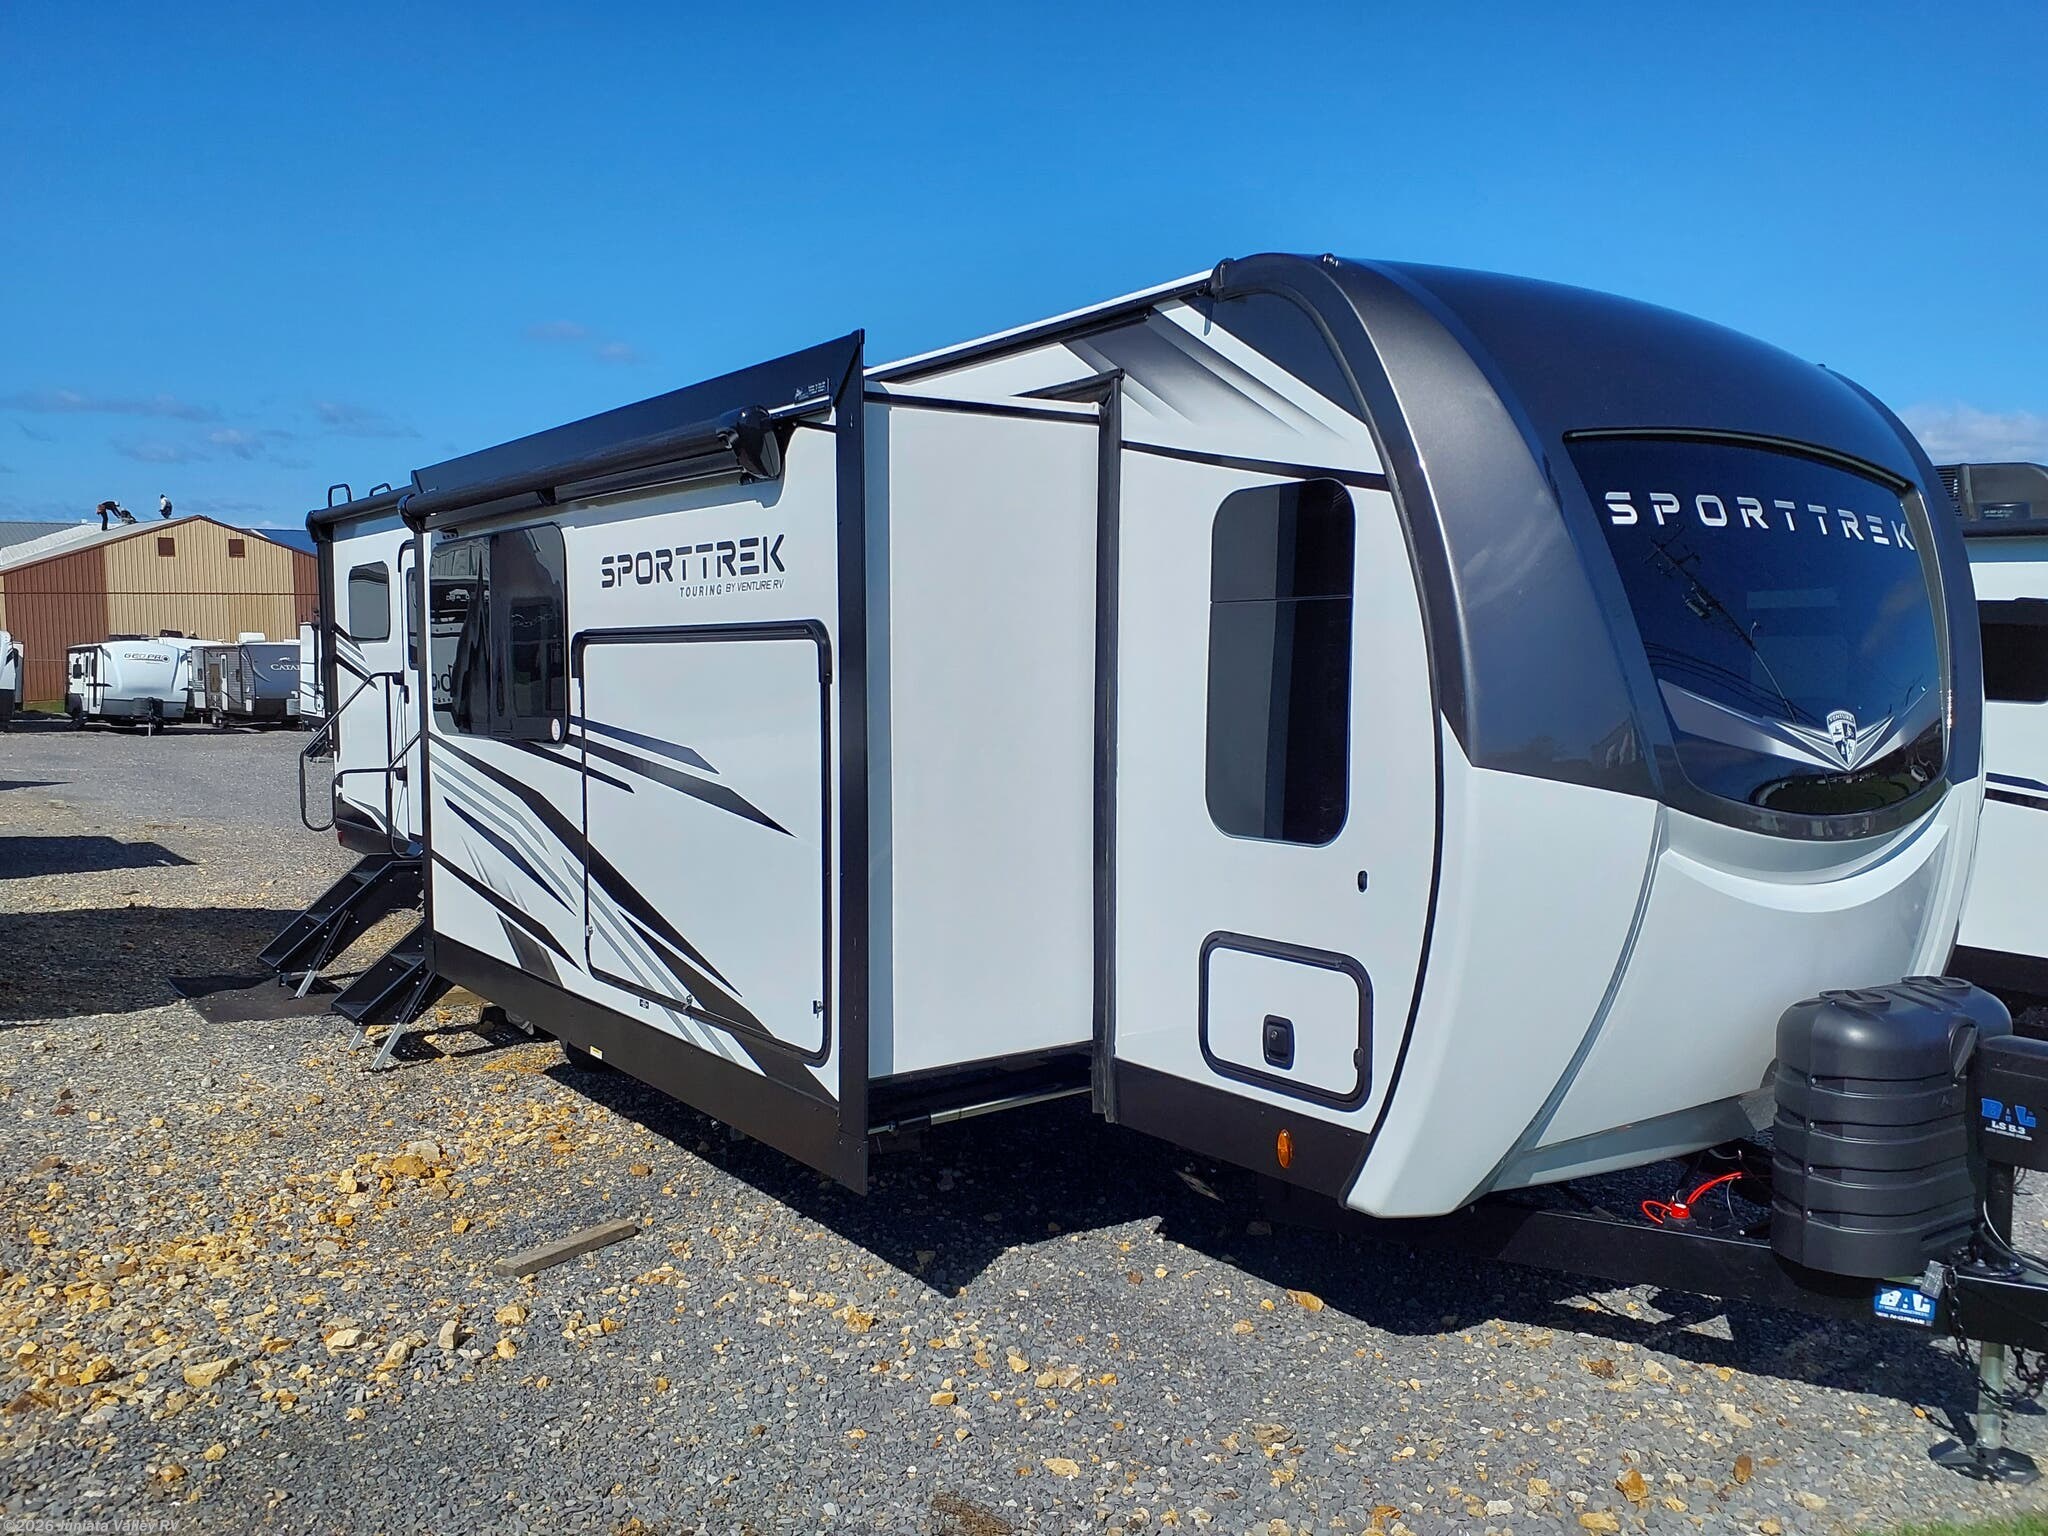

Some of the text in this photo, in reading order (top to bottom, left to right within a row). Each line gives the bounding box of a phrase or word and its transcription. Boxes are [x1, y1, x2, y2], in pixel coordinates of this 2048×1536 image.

[1604, 492, 1916, 551] SPORTTREK
[601, 534, 786, 589] SPORTTREK
[679, 578, 785, 598] TOURING BY VENTURE RV
[123, 652, 147, 660] GEO
